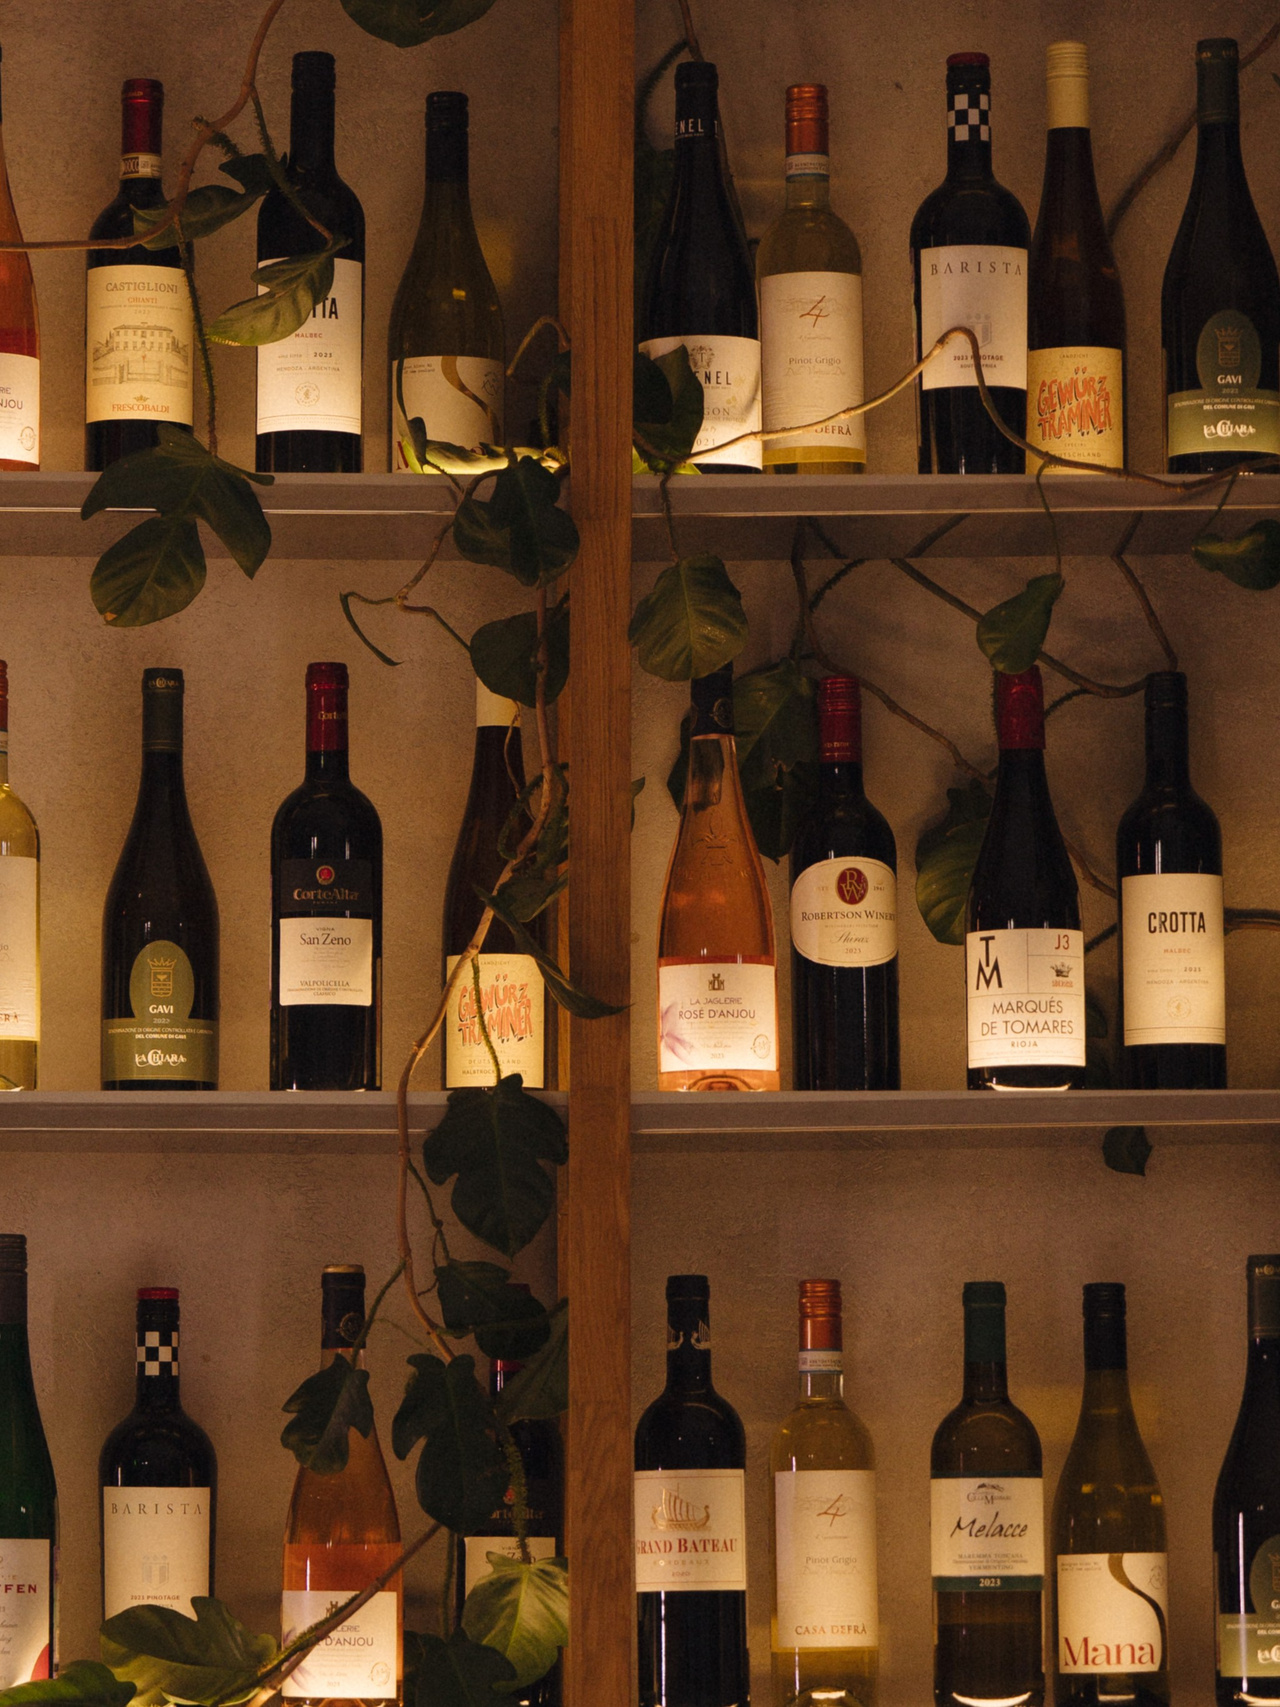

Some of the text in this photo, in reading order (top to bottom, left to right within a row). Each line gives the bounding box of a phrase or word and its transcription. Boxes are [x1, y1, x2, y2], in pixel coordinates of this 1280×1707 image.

[931, 261, 1022, 276] BARISTA
[106, 281, 178, 294] CASTIGLIONI
[800, 296, 830, 328] 4
[815, 356, 841, 366] Grigio
[1217, 374, 1242, 384] GAVI
[1038, 366, 1108, 417] GEWÜRZ
[112, 403, 170, 413] FRESCOBALDI
[1038, 391, 1113, 441] TRAMINER
[802, 911, 862, 921] ROBERTSON
[864, 910, 895, 921] WINERY
[1148, 912, 1206, 934] CROTTA
[300, 933, 351, 947] San Zeno
[1055, 934, 1069, 950] J3
[690, 997, 700, 1005] LA
[992, 996, 1063, 1014] MARQUÉS
[149, 1005, 173, 1015] GAVI
[679, 1009, 756, 1020] ROSÉ D'ANJOU
[982, 1020, 1073, 1035] DE TOMARES
[111, 1503, 202, 1515] BARISTA
[816, 1494, 847, 1526] 4
[950, 1512, 1028, 1539] Melacce
[678, 1537, 737, 1553] BATEAU
[832, 1556, 858, 1566] Grigio
[795, 1624, 867, 1635] CASA DEFRÀ
[326, 1635, 373, 1646] D'ANJOU
[1063, 1636, 1155, 1667] Mana
